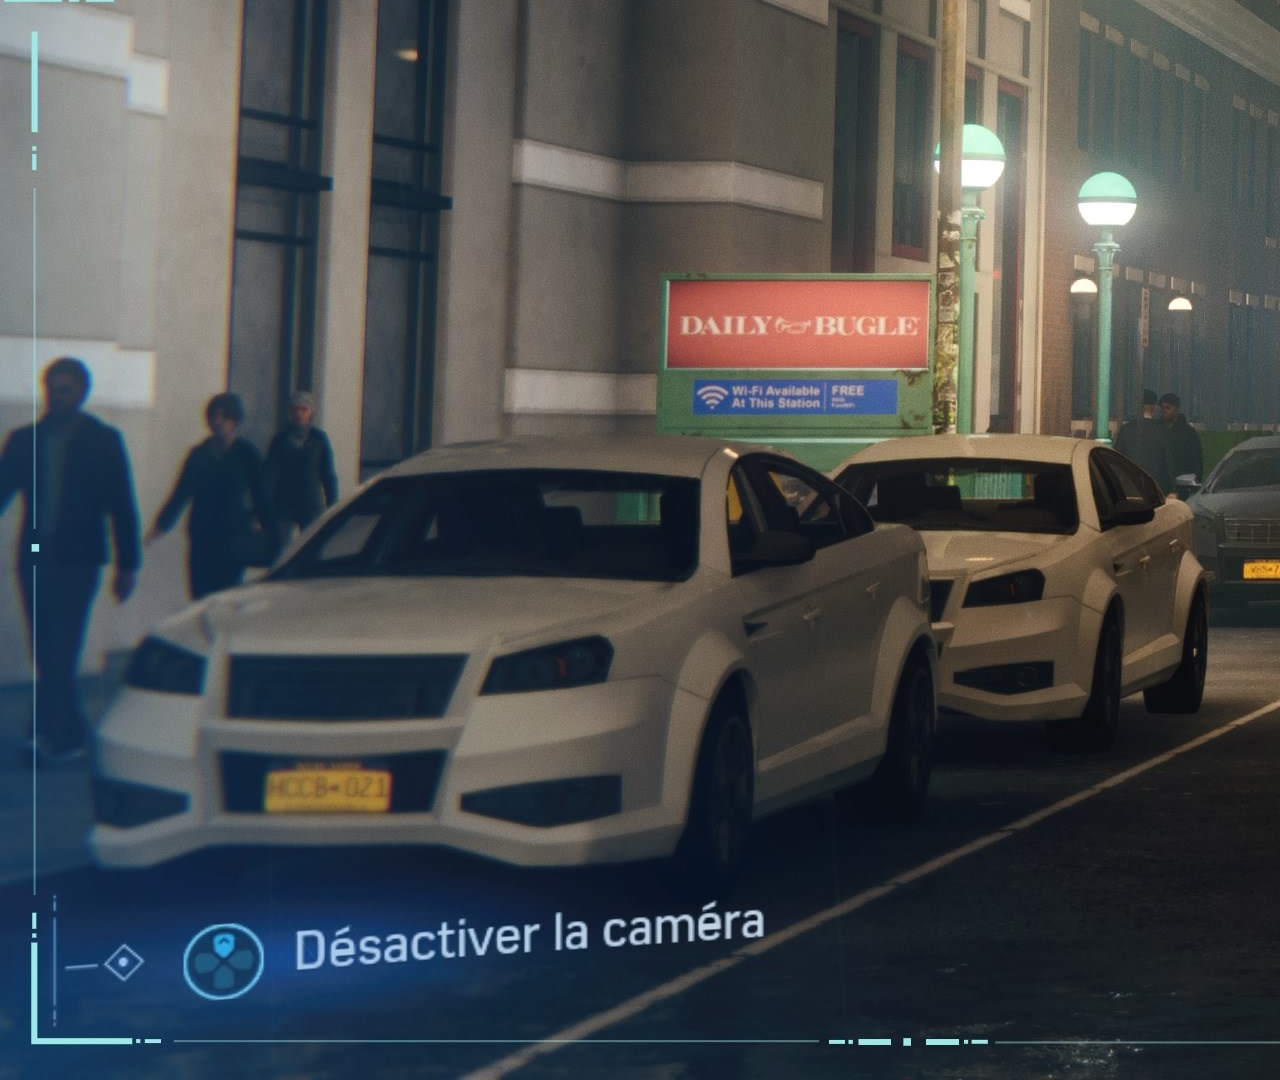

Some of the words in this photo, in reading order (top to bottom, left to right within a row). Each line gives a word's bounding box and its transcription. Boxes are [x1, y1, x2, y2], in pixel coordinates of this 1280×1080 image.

[679, 315, 773, 336] DAILY
[814, 315, 921, 337] BUGLE
[731, 385, 763, 396] Wi-Fi
[766, 385, 821, 396] Available
[831, 385, 866, 396] FREE
[731, 398, 746, 409] At
[749, 398, 775, 409] This
[778, 398, 821, 409] Station
